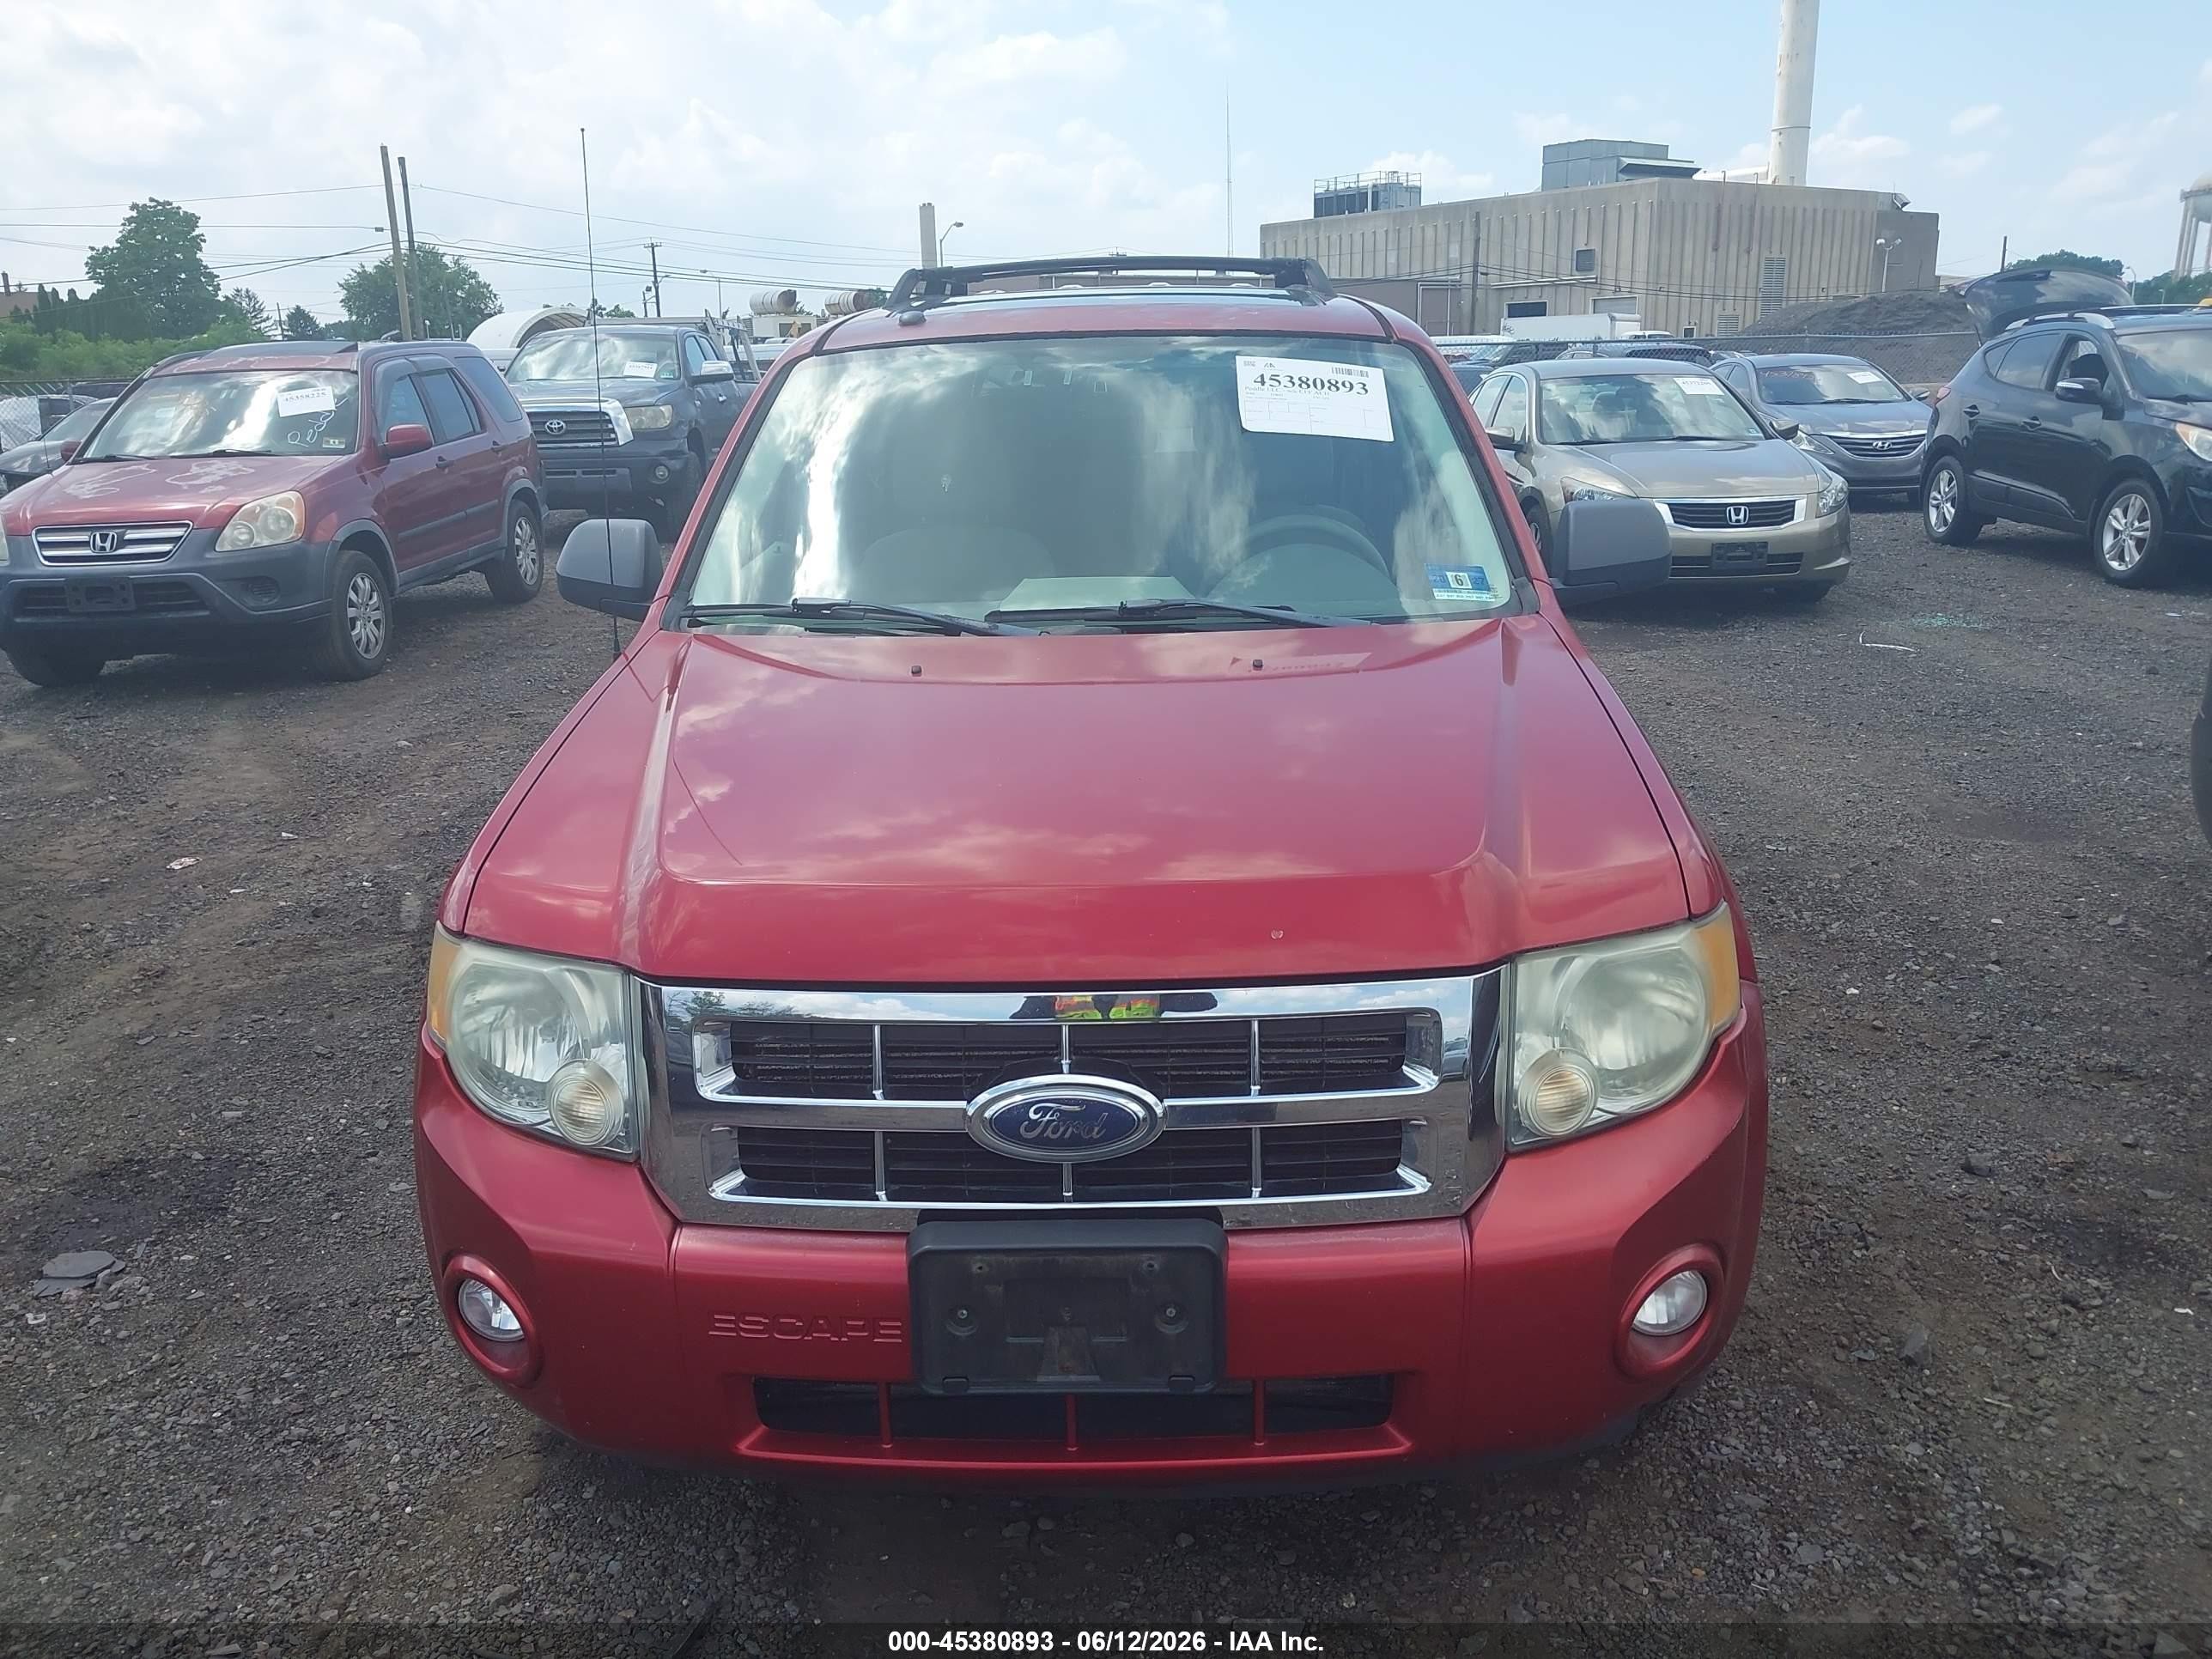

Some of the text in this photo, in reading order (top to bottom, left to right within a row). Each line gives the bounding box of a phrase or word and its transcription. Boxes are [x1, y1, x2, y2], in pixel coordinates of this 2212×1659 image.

[1253, 373, 1369, 396] 45380893
[1454, 574, 1464, 586] 6
[1019, 1103, 1109, 1139] Ford
[708, 1314, 902, 1343] ESCAPE
